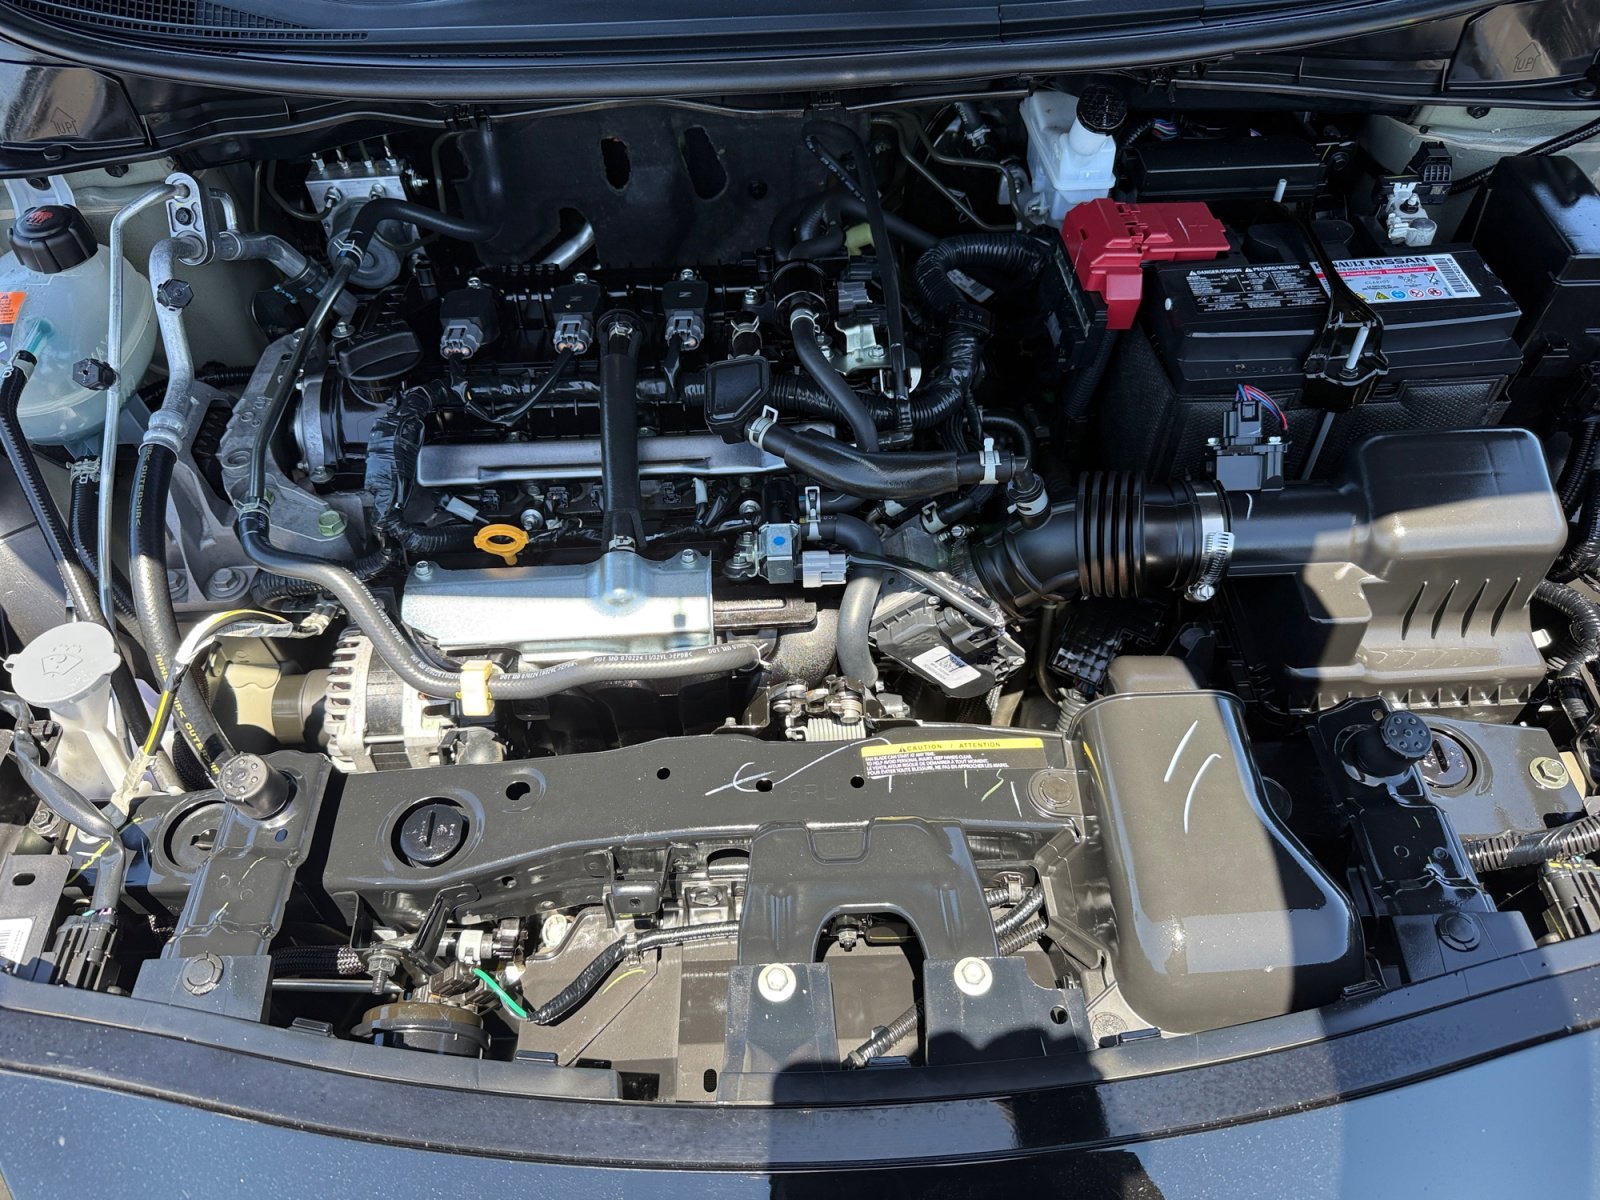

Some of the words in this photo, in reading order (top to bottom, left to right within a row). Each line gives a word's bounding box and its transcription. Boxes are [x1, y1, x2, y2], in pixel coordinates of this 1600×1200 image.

[1516, 56, 1534, 70] UP
[56, 121, 72, 134] UP
[1370, 257, 1427, 266] NISSAN
[1196, 268, 1242, 276] DANGER/POISON
[1252, 264, 1300, 272] PELIGRO/VENENO
[906, 744, 942, 752] CAUTION
